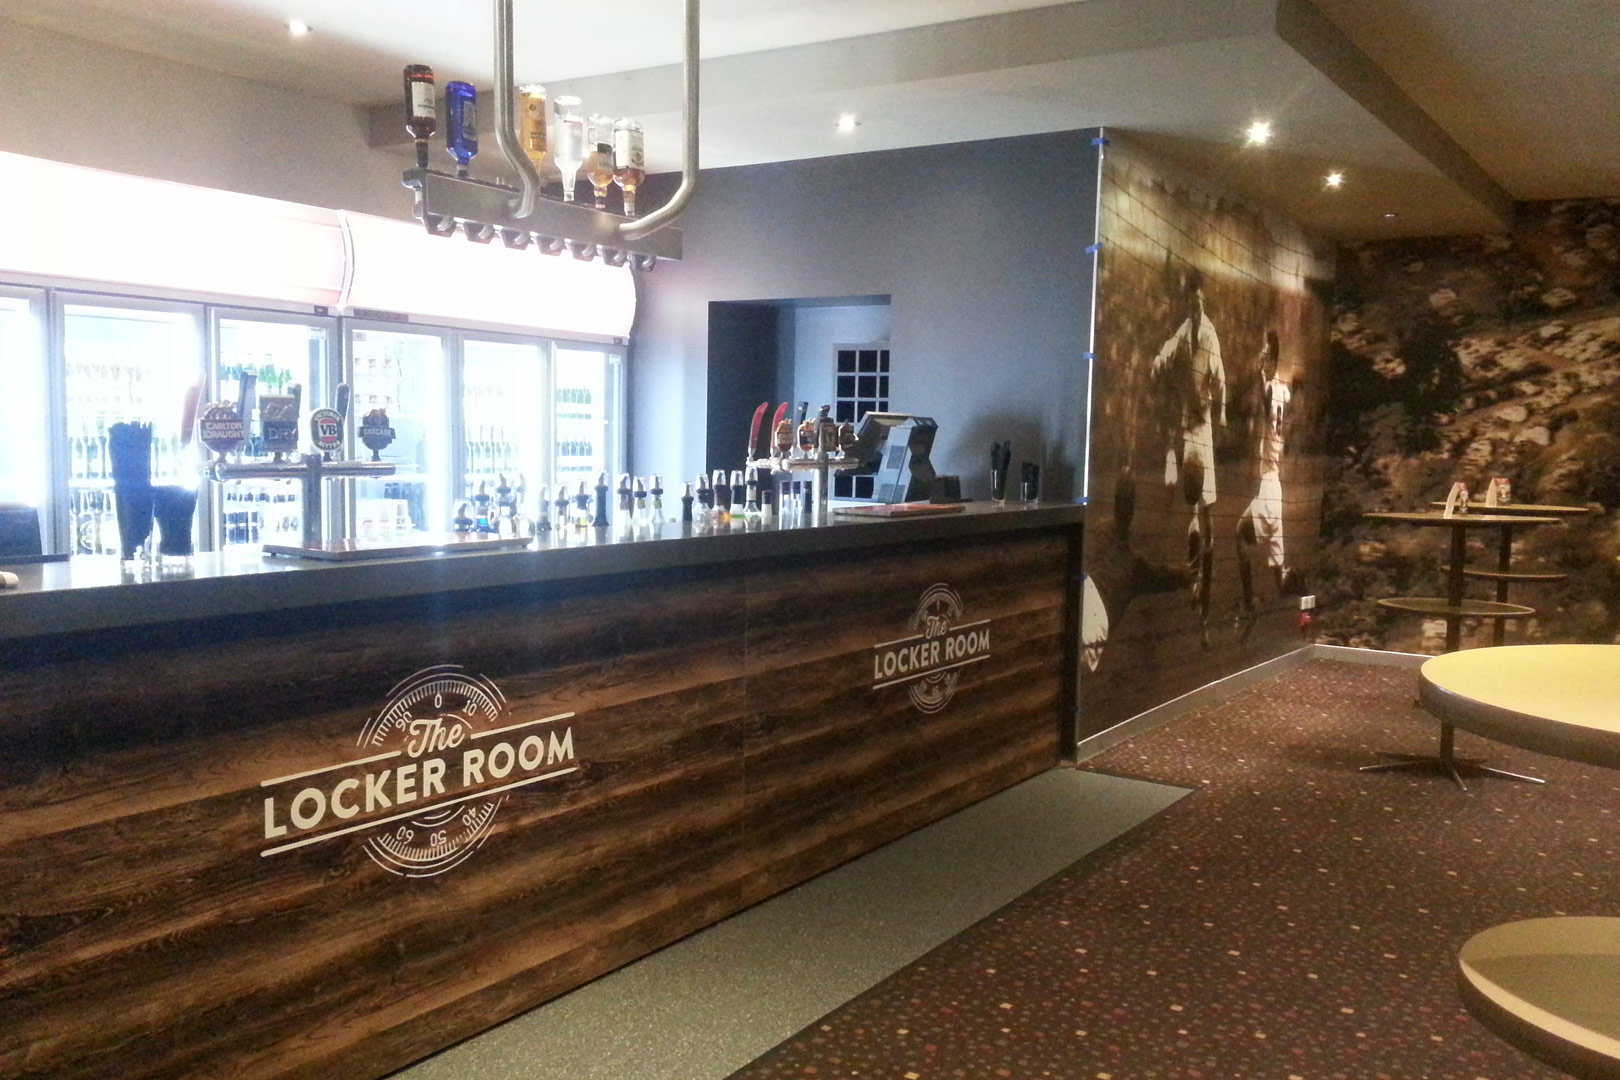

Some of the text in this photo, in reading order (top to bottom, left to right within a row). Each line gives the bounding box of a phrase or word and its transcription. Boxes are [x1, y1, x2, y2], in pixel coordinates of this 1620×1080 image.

[203, 430, 244, 439] DRAUGHT
[205, 422, 243, 431] CARLTON
[268, 427, 297, 440] DRY
[320, 424, 337, 436] VB
[363, 427, 392, 437] CASCADE
[318, 441, 341, 449] BITTER
[925, 615, 947, 640] The
[874, 628, 990, 680] LOCKER ROOM
[462, 699, 477, 717] 10
[395, 711, 413, 733] 90
[407, 717, 466, 759] The
[264, 726, 575, 839] LOCKER ROOM
[462, 806, 477, 827] 40
[396, 826, 415, 845] 60
[430, 829, 447, 847] 50
